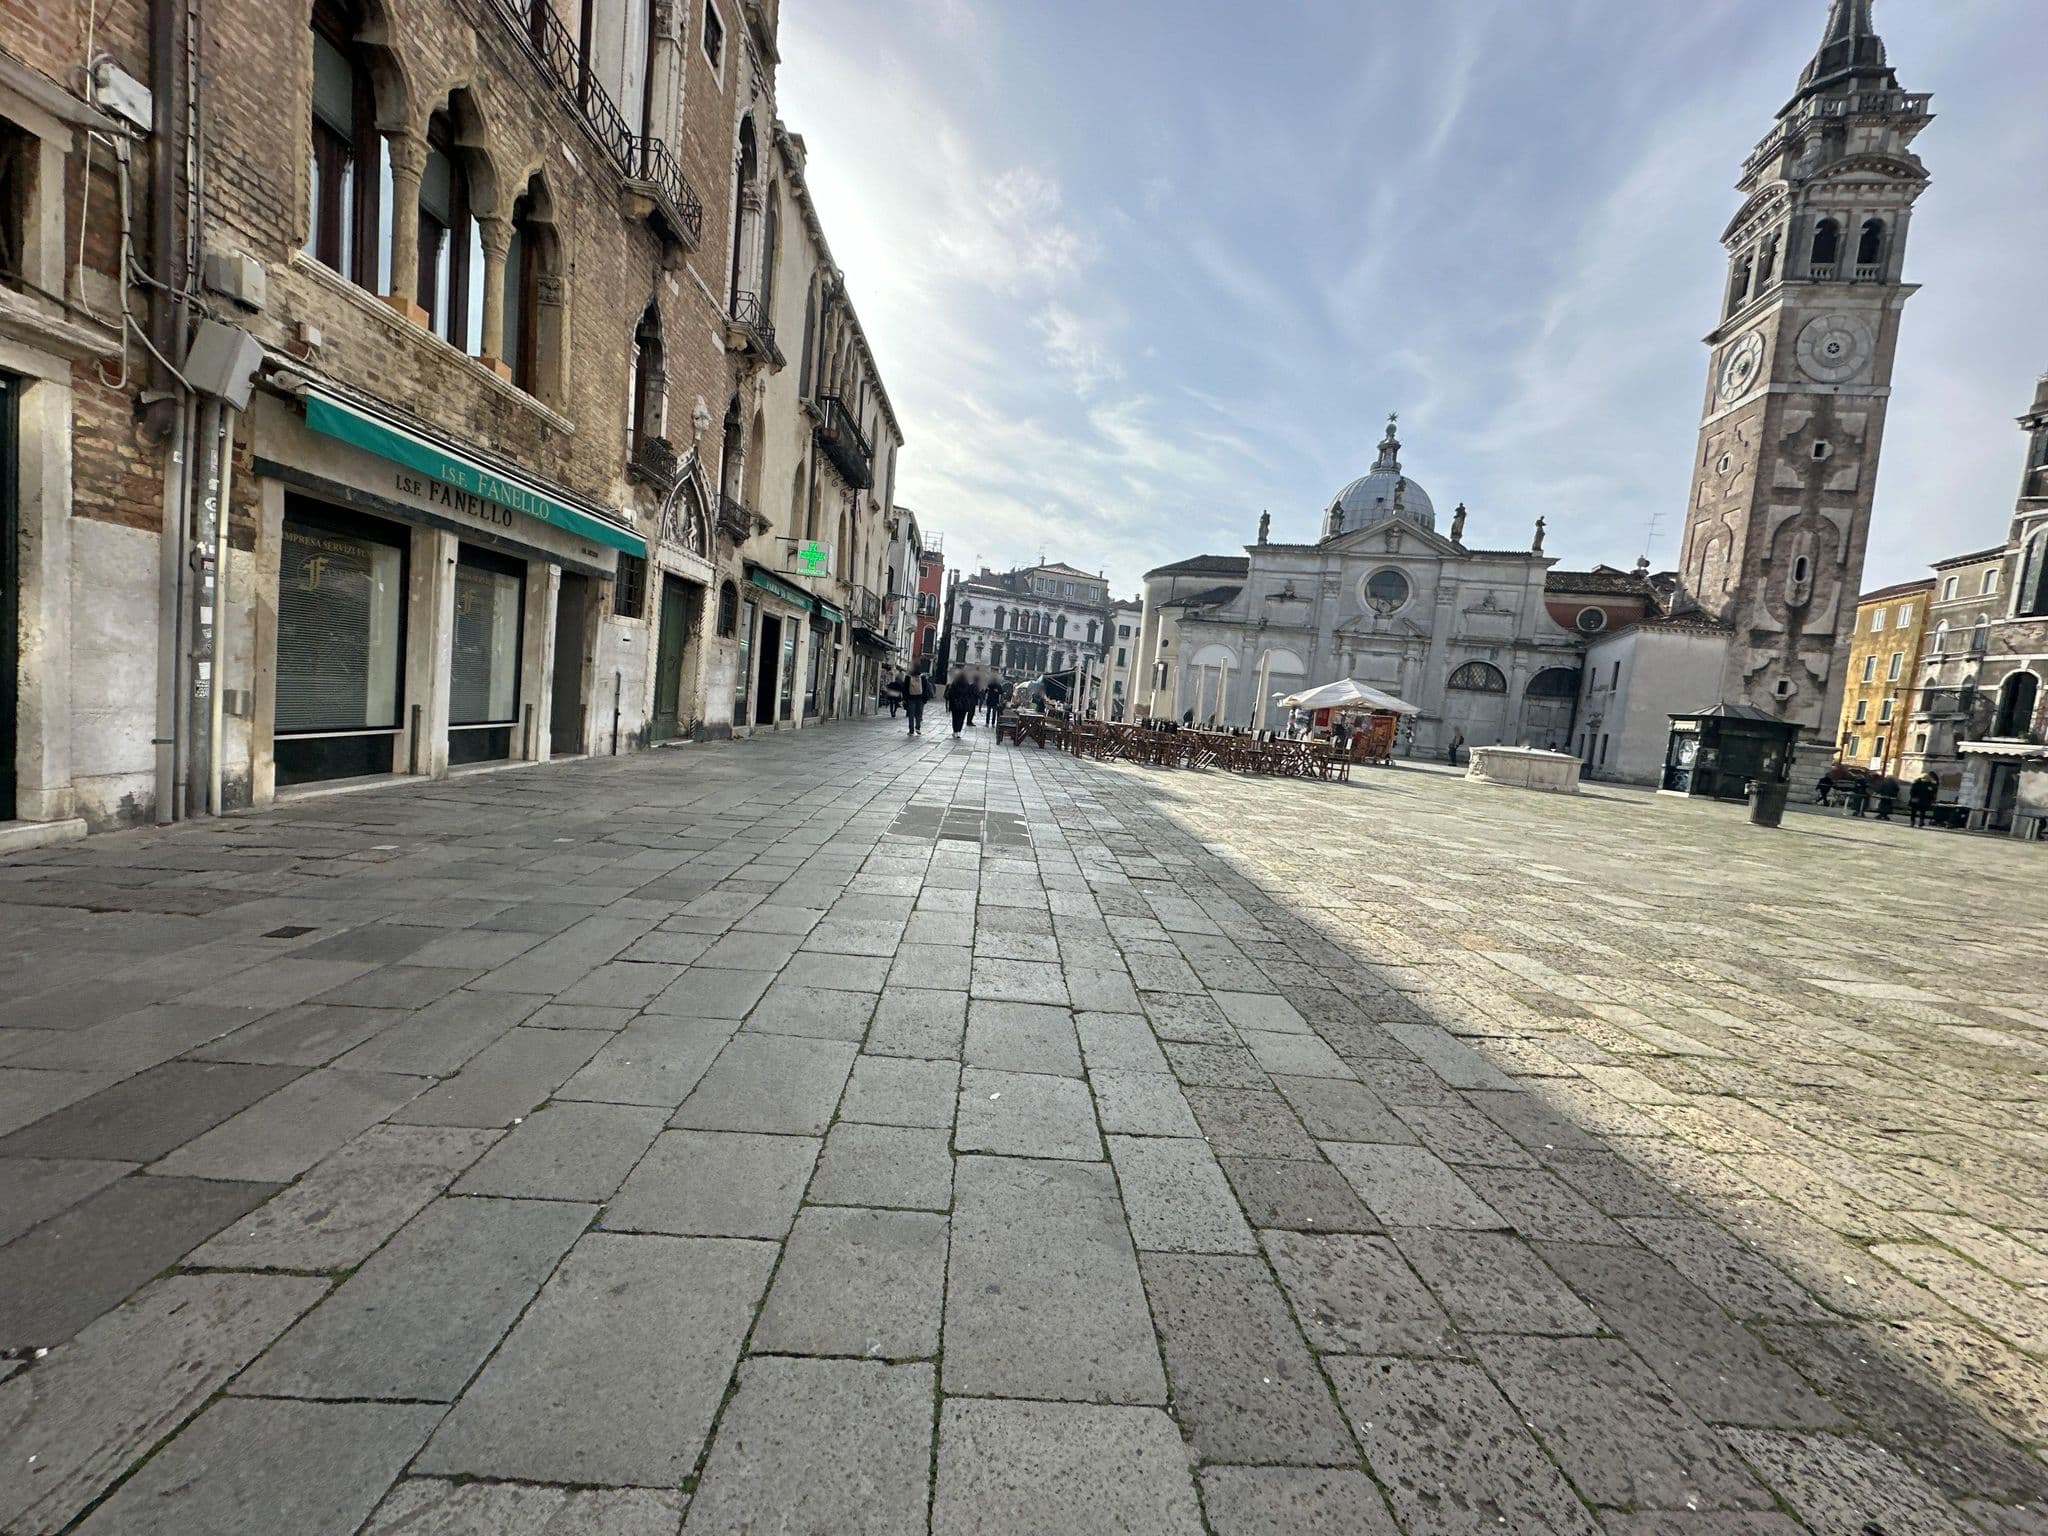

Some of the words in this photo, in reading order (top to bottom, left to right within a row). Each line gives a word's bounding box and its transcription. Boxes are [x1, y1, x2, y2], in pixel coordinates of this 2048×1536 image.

[396, 474, 421, 496] I.S.F.
[429, 479, 512, 527] FANELLO
[441, 463, 468, 487] I.S.F.
[478, 473, 550, 519] FANELLO
